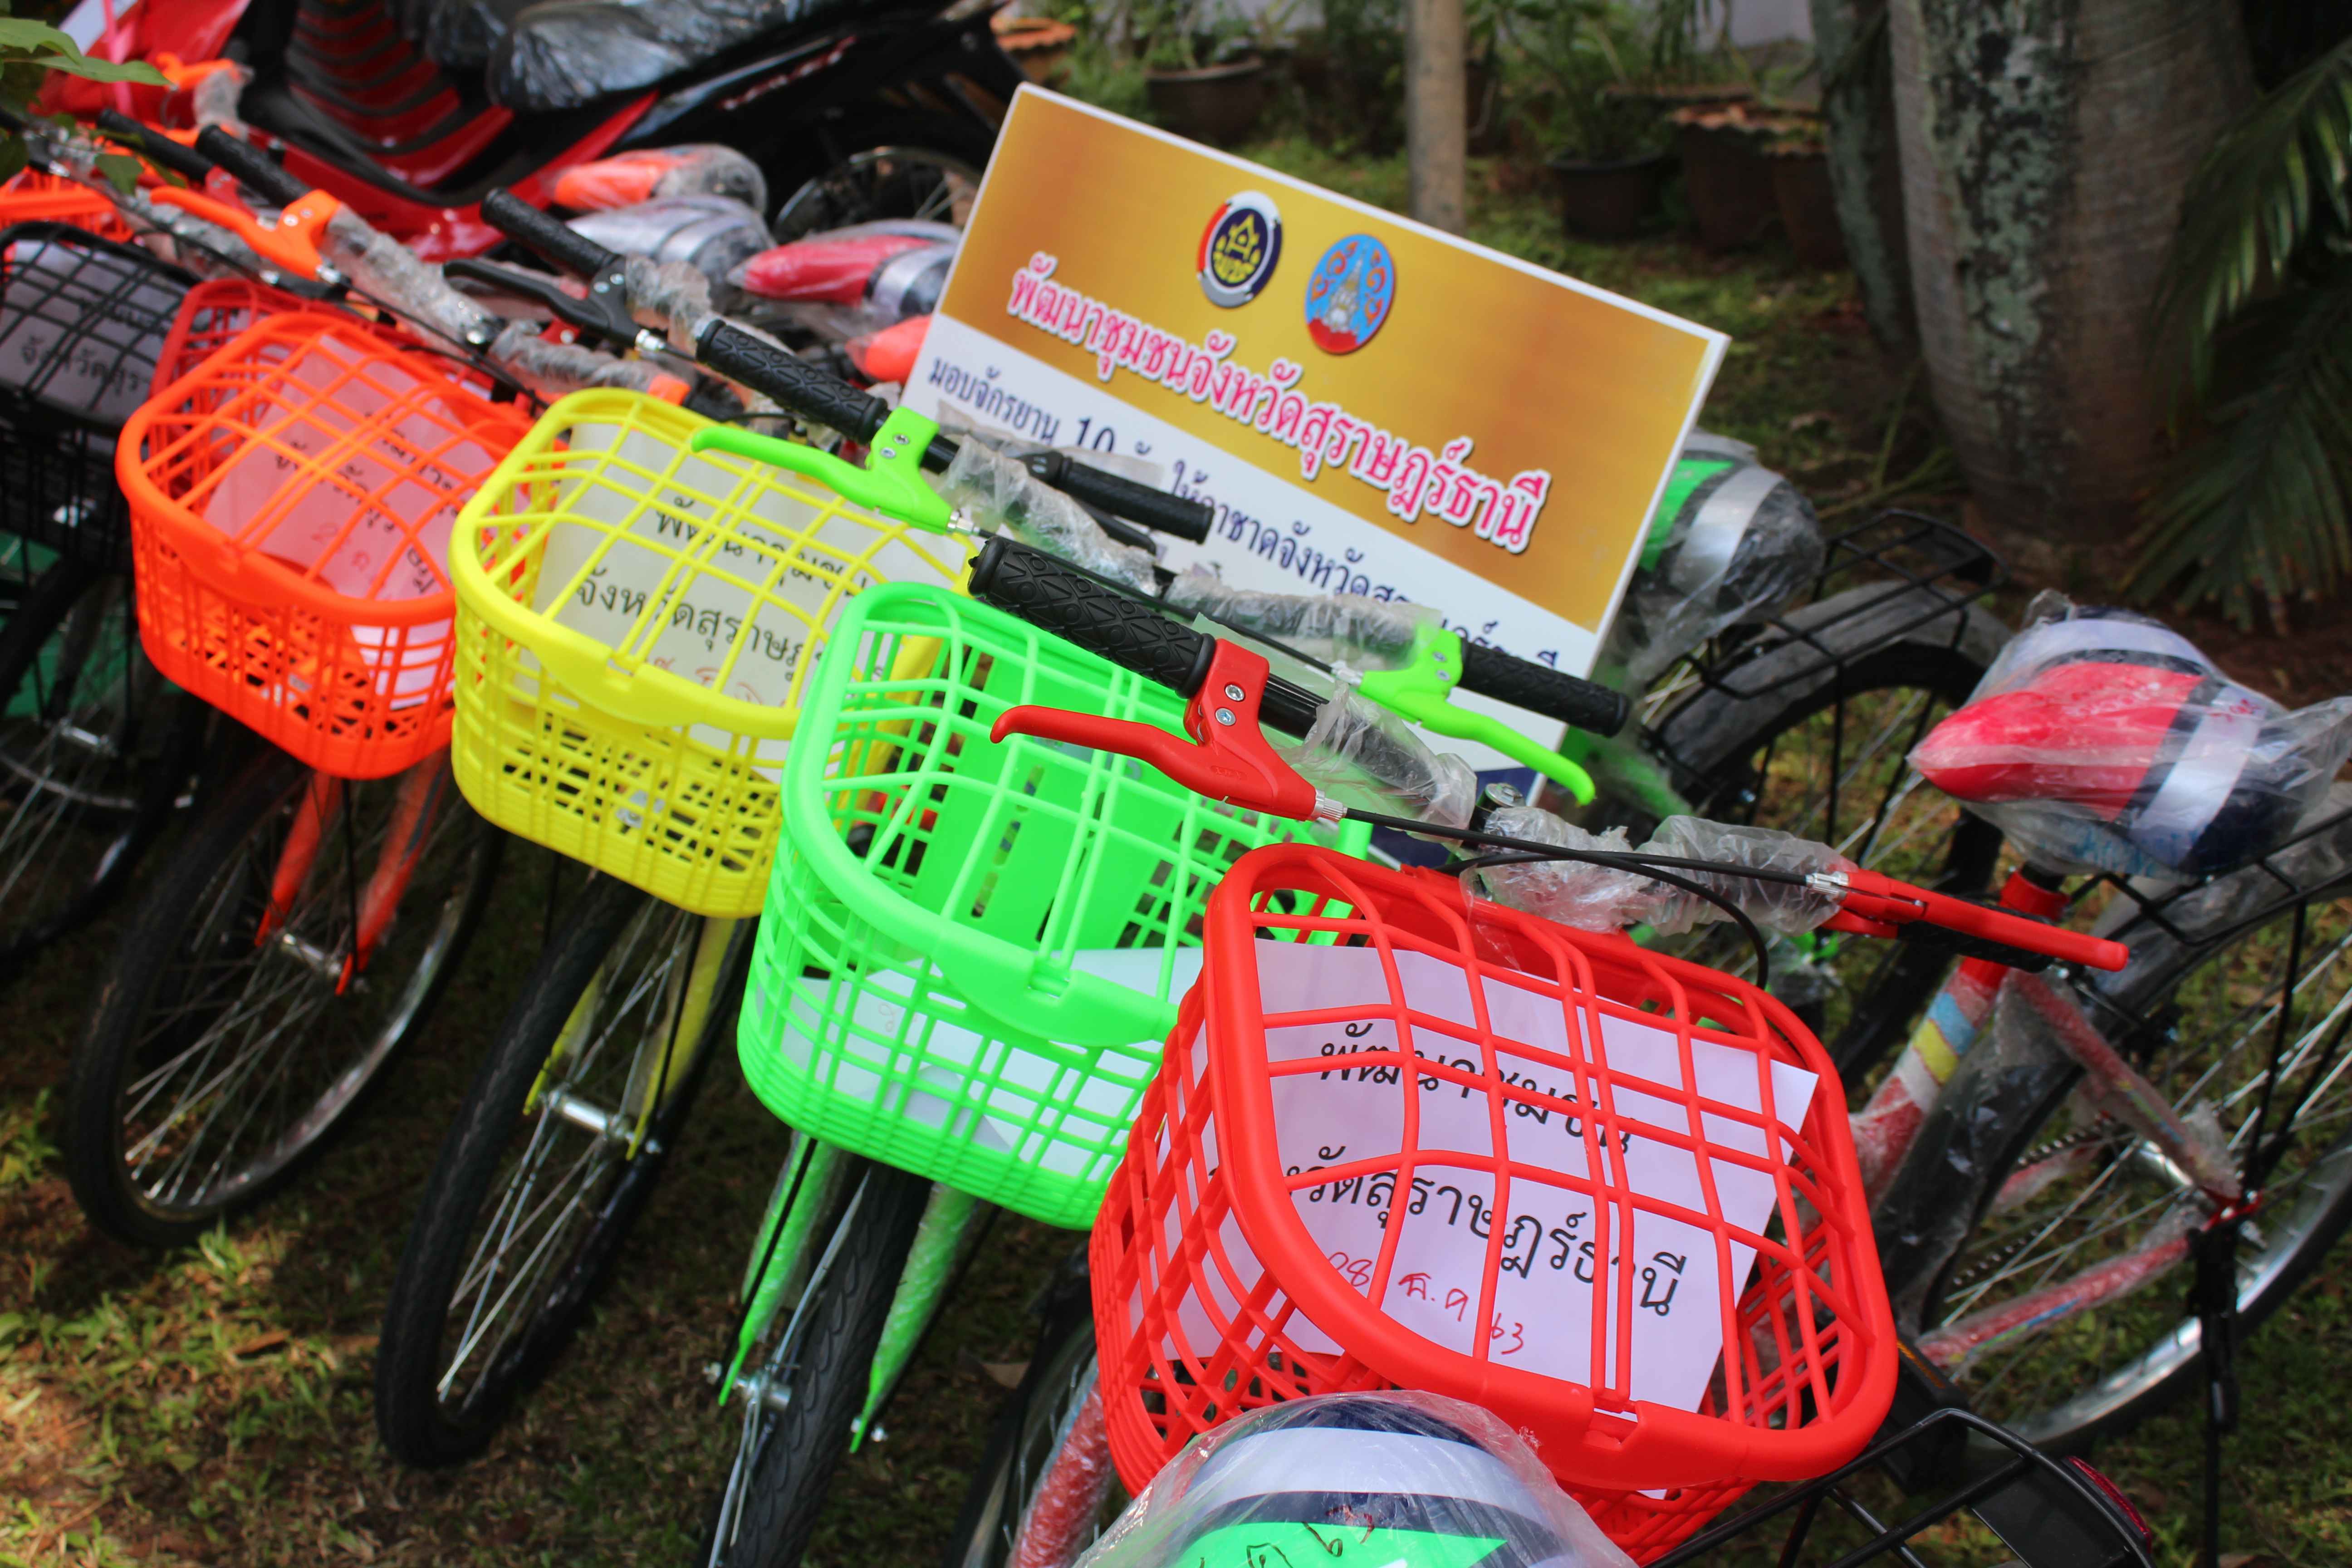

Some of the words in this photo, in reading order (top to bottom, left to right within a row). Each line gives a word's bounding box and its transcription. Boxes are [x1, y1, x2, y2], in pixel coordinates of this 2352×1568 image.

[928, 358, 1061, 446] มอบจักรยาน
[1078, 417, 1116, 453] 10
